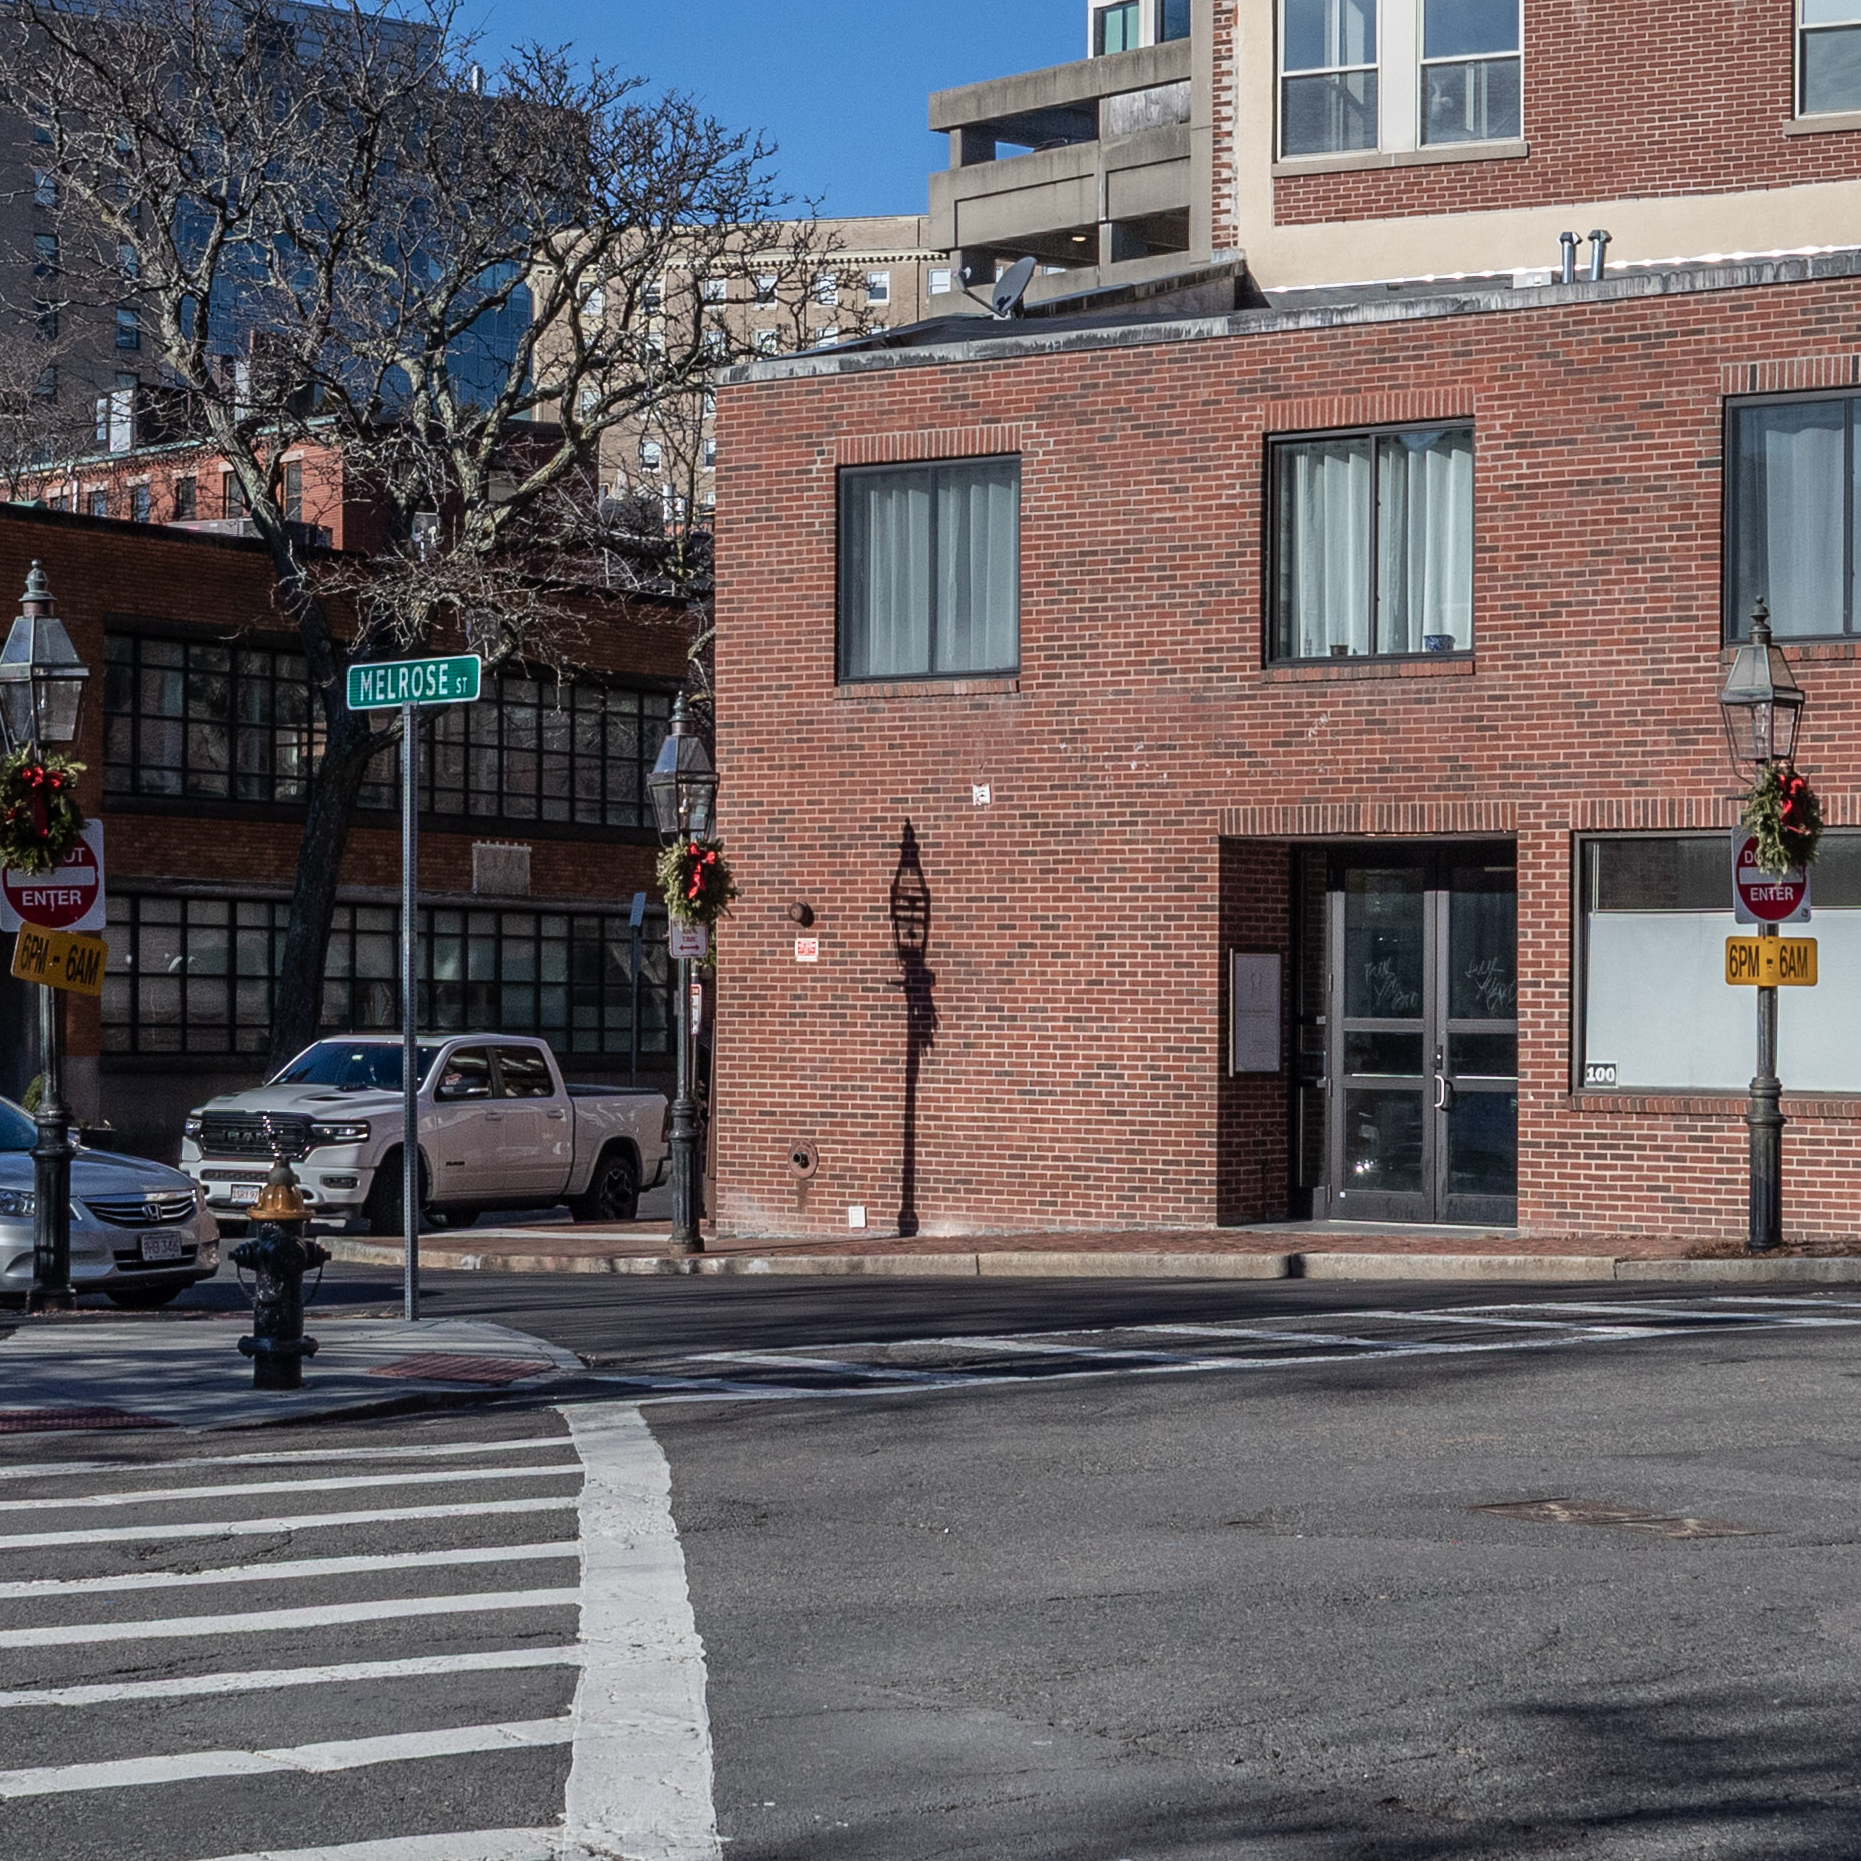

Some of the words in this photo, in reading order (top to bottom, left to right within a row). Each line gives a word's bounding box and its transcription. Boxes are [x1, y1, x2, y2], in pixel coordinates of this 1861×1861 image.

[360, 663, 449, 701] MELROSE
[456, 677, 468, 694] ST
[22, 890, 82, 907] ENTER
[1750, 887, 1794, 902] ENTER
[20, 933, 50, 975] 6PM
[65, 944, 101, 986] 6AM
[1729, 945, 1760, 978] 6PM
[1779, 945, 1808, 978] 6AM
[1586, 1066, 1616, 1082] 100
